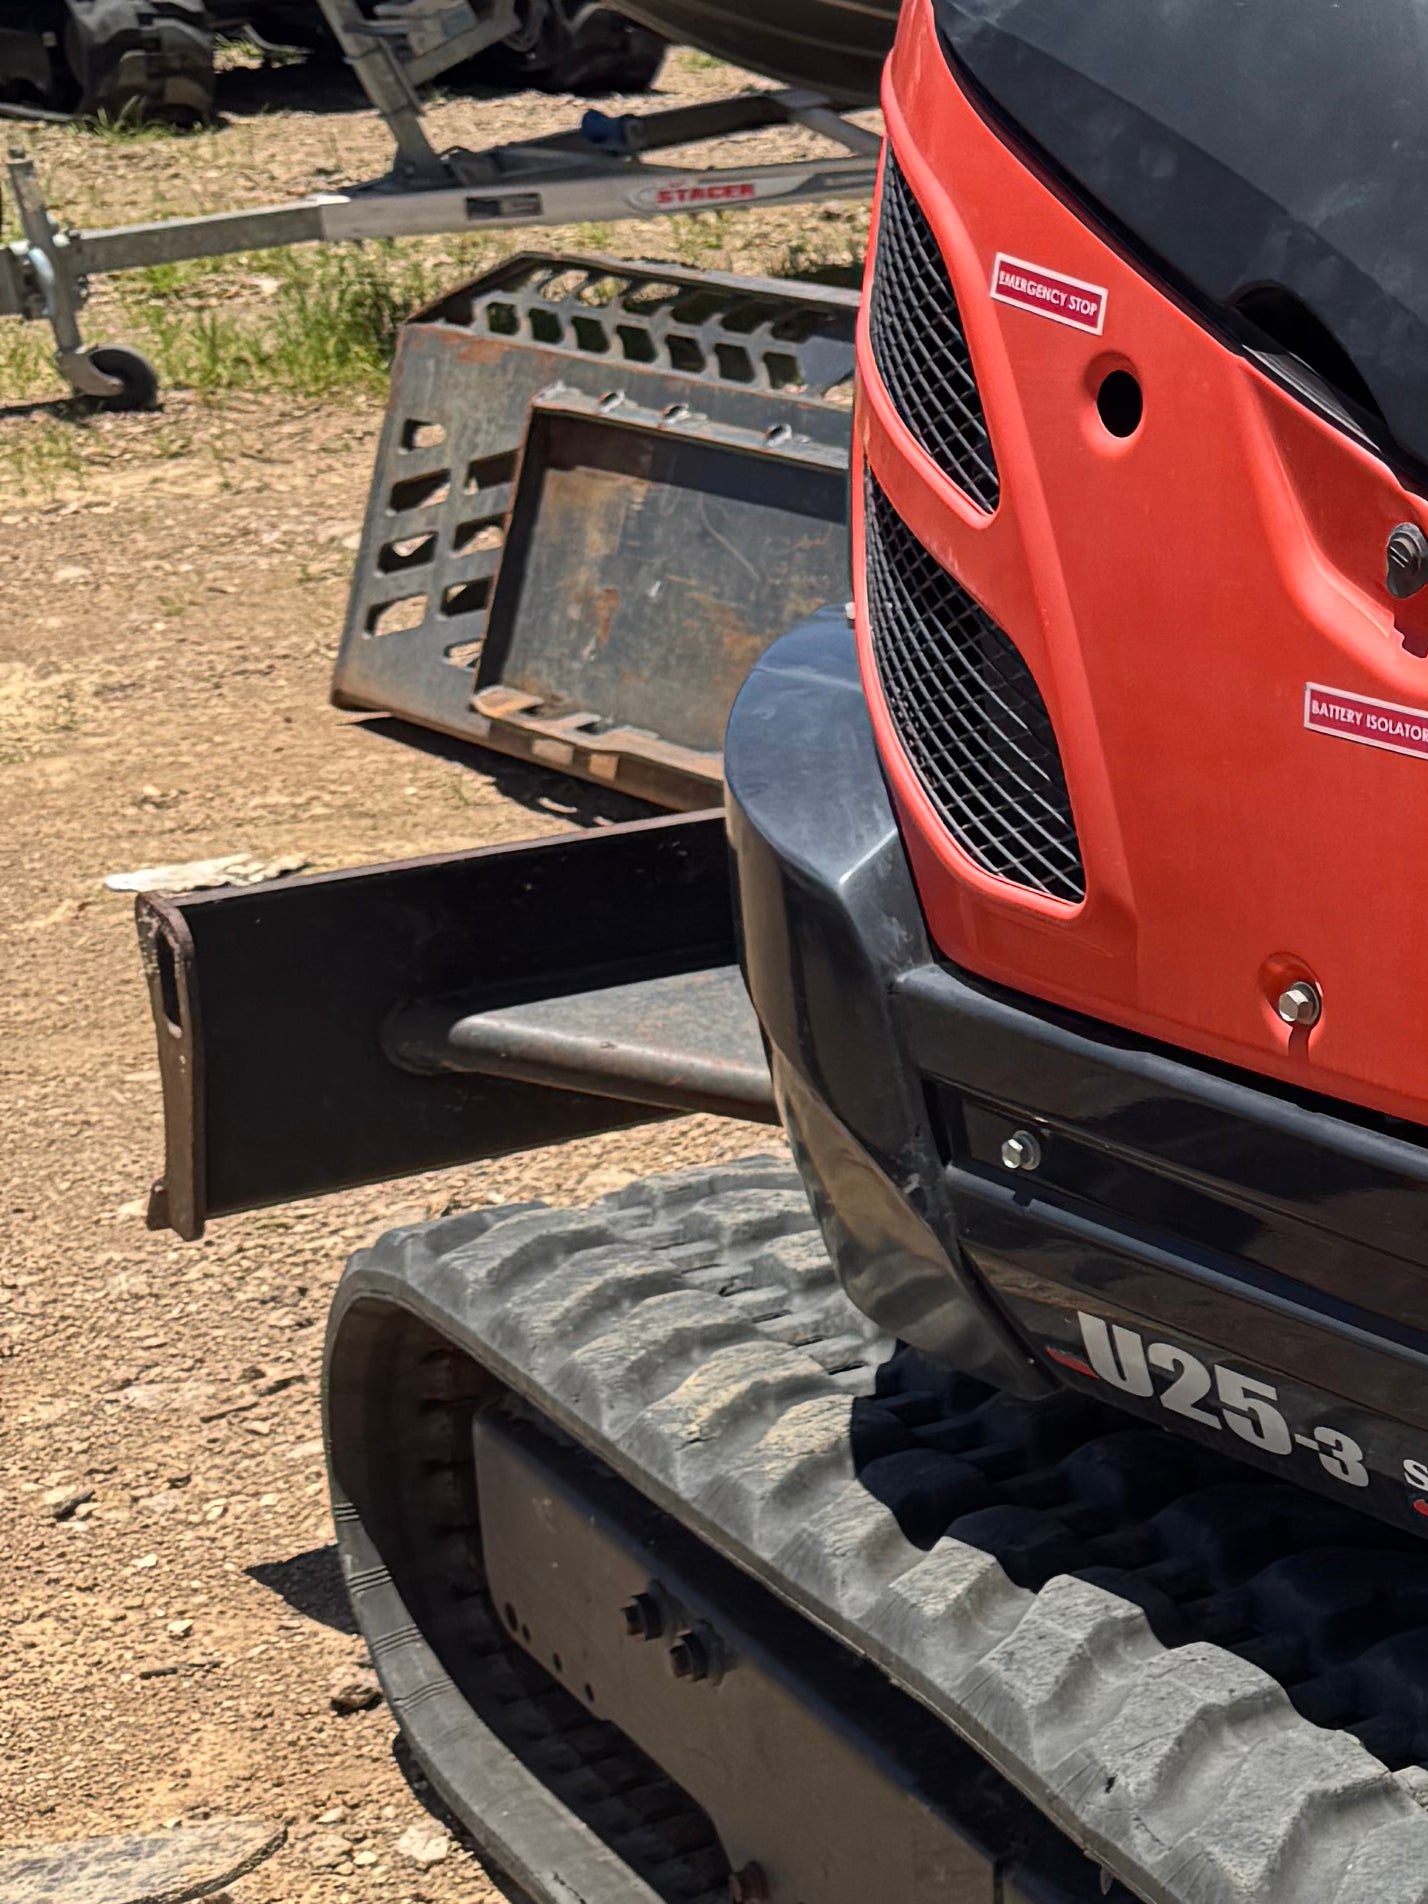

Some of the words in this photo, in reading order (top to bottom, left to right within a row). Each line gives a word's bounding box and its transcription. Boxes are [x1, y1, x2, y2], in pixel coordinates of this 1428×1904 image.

[656, 183, 755, 204] STACER
[998, 270, 1068, 306] EMERGENCY
[1068, 295, 1098, 316] STOP
[1311, 699, 1363, 726] BATTERY
[1075, 1308, 1371, 1488] U25-3
